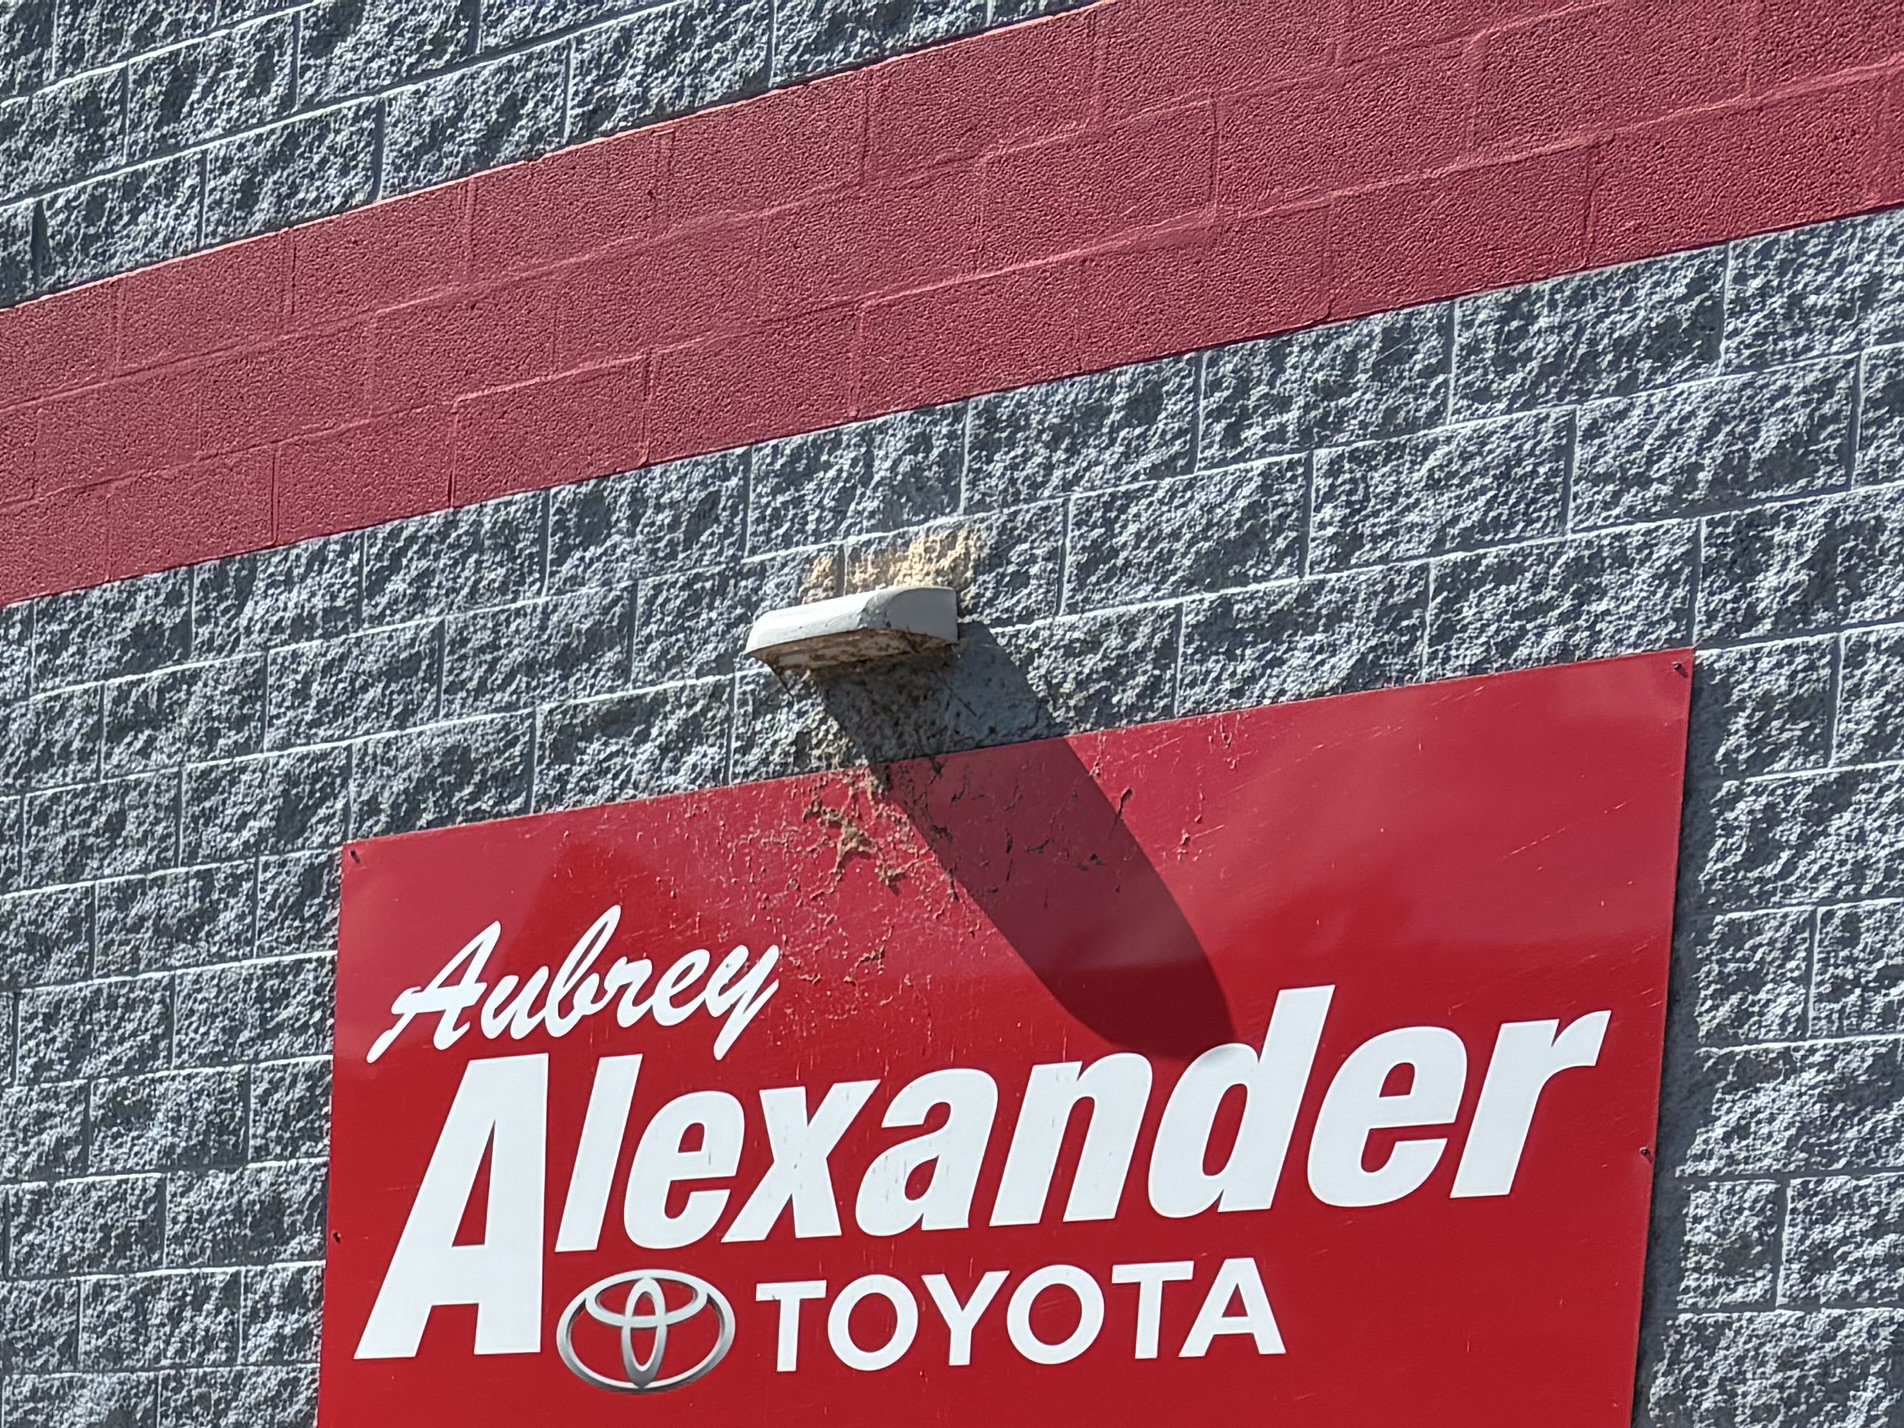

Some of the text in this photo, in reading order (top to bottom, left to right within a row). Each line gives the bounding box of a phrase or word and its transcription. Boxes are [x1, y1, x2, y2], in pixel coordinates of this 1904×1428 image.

[367, 905, 779, 1064] Aubrey
[354, 985, 1612, 1360] Alexander
[755, 1258, 1287, 1373] TOYOTA
